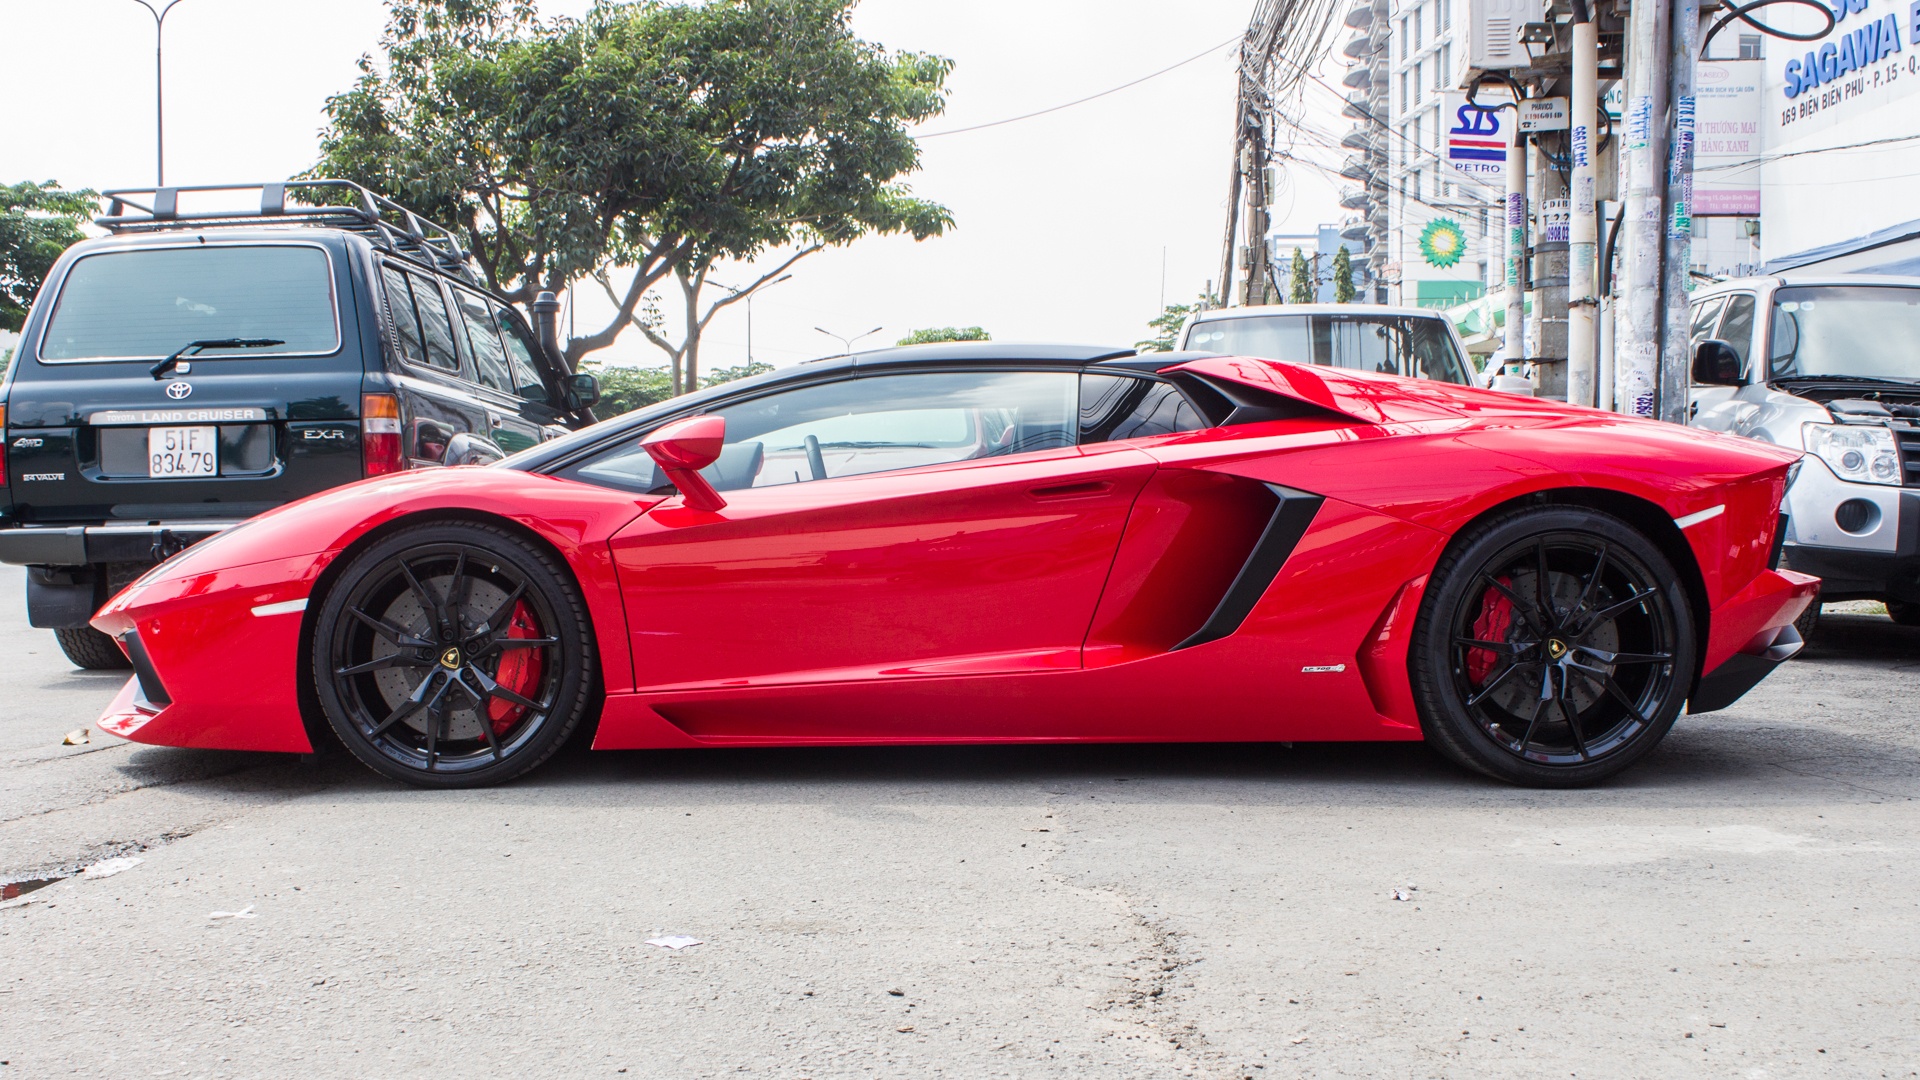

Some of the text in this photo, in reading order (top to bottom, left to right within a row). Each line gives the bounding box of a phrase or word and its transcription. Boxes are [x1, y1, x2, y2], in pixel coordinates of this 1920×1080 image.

[1784, 13, 1902, 99] SAGAWA
[1781, 106, 1796, 127] 169
[1800, 95, 1819, 120] ĐIỆN
[1822, 85, 1842, 110] BIÊN
[1845, 69, 1865, 100] PHỦ
[1874, 62, 1898, 88] P.15
[1531, 103, 1553, 111] PHAVICO
[1705, 121, 1738, 134] THƯƠNG
[1726, 141, 1749, 152] XANH
[1455, 163, 1500, 173] PETRO
[142, 412, 183, 422] LAND
[187, 410, 255, 421] CRUISER
[13, 437, 44, 448] 4WD
[165, 429, 200, 451] 51F
[152, 452, 214, 474] 834.79
